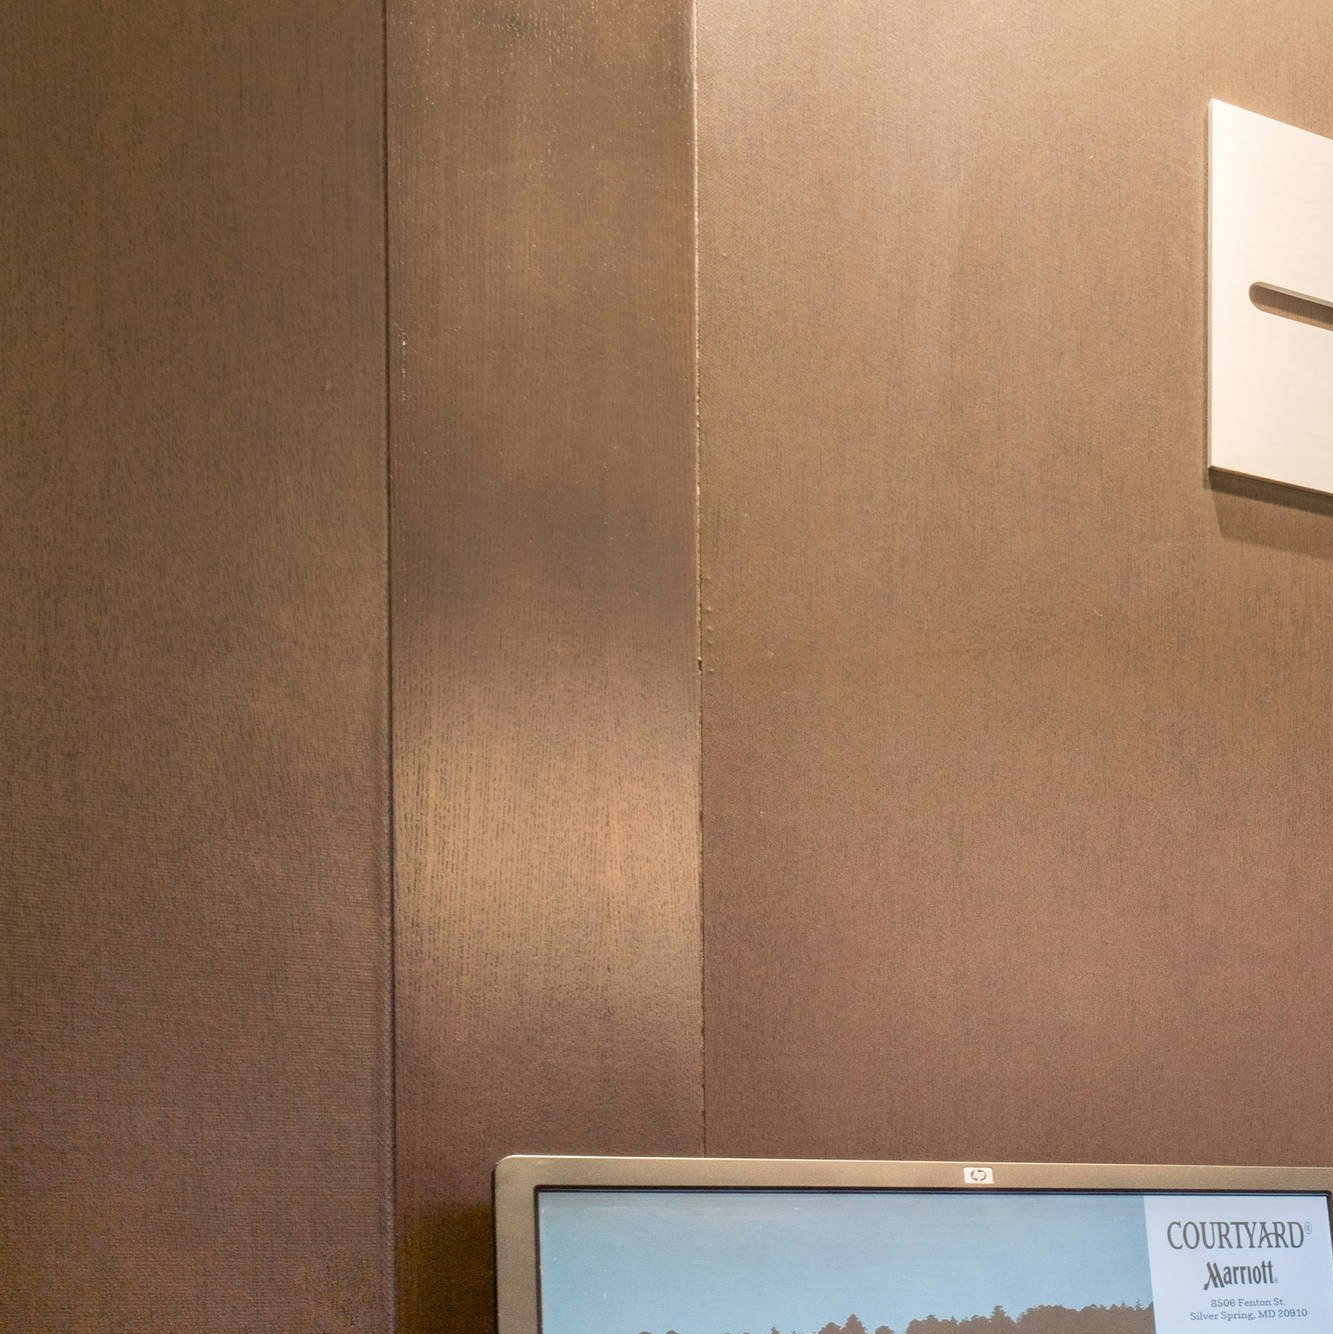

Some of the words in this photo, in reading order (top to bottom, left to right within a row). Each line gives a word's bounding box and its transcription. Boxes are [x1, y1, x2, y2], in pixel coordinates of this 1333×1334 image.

[1203, 1260, 1275, 1290] Marriott
[1238, 1298, 1272, 1307] Fenton
[1273, 1297, 1286, 1306] St.
[1190, 1311, 1218, 1321] Silver
[1220, 1311, 1257, 1322] Spring,
[1258, 1310, 1276, 1319] MD
[1278, 1308, 1308, 1318] 20910
